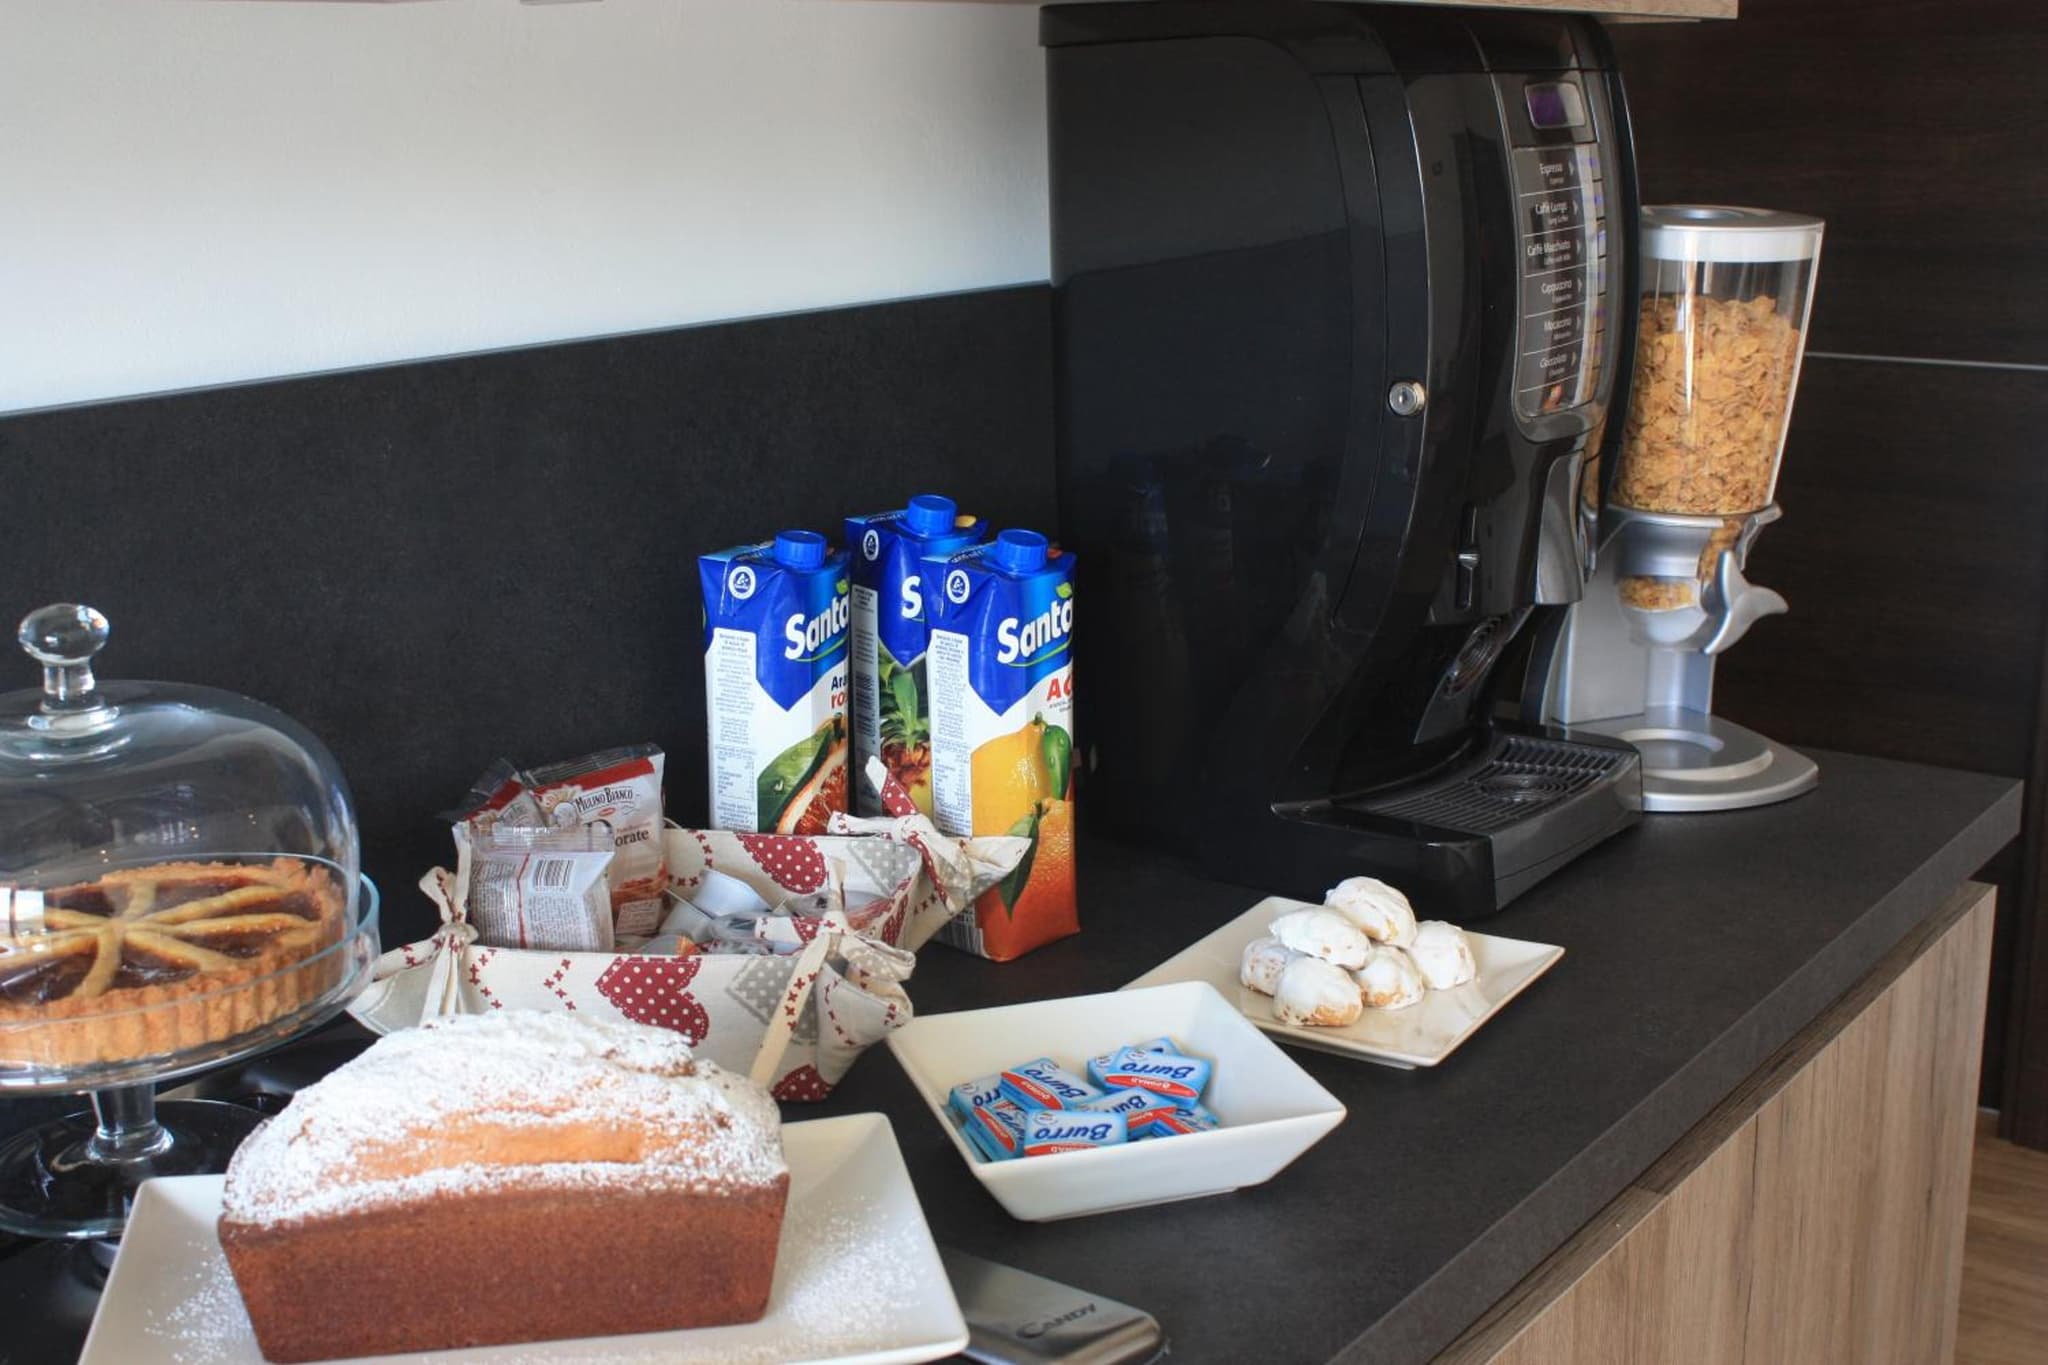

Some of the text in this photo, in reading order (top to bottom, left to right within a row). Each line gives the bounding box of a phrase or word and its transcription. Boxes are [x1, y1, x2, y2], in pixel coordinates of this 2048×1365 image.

[1121, 1063, 1195, 1079] Burro
[1024, 1069, 1088, 1098] Burro
[1034, 1123, 1113, 1141] Burro
